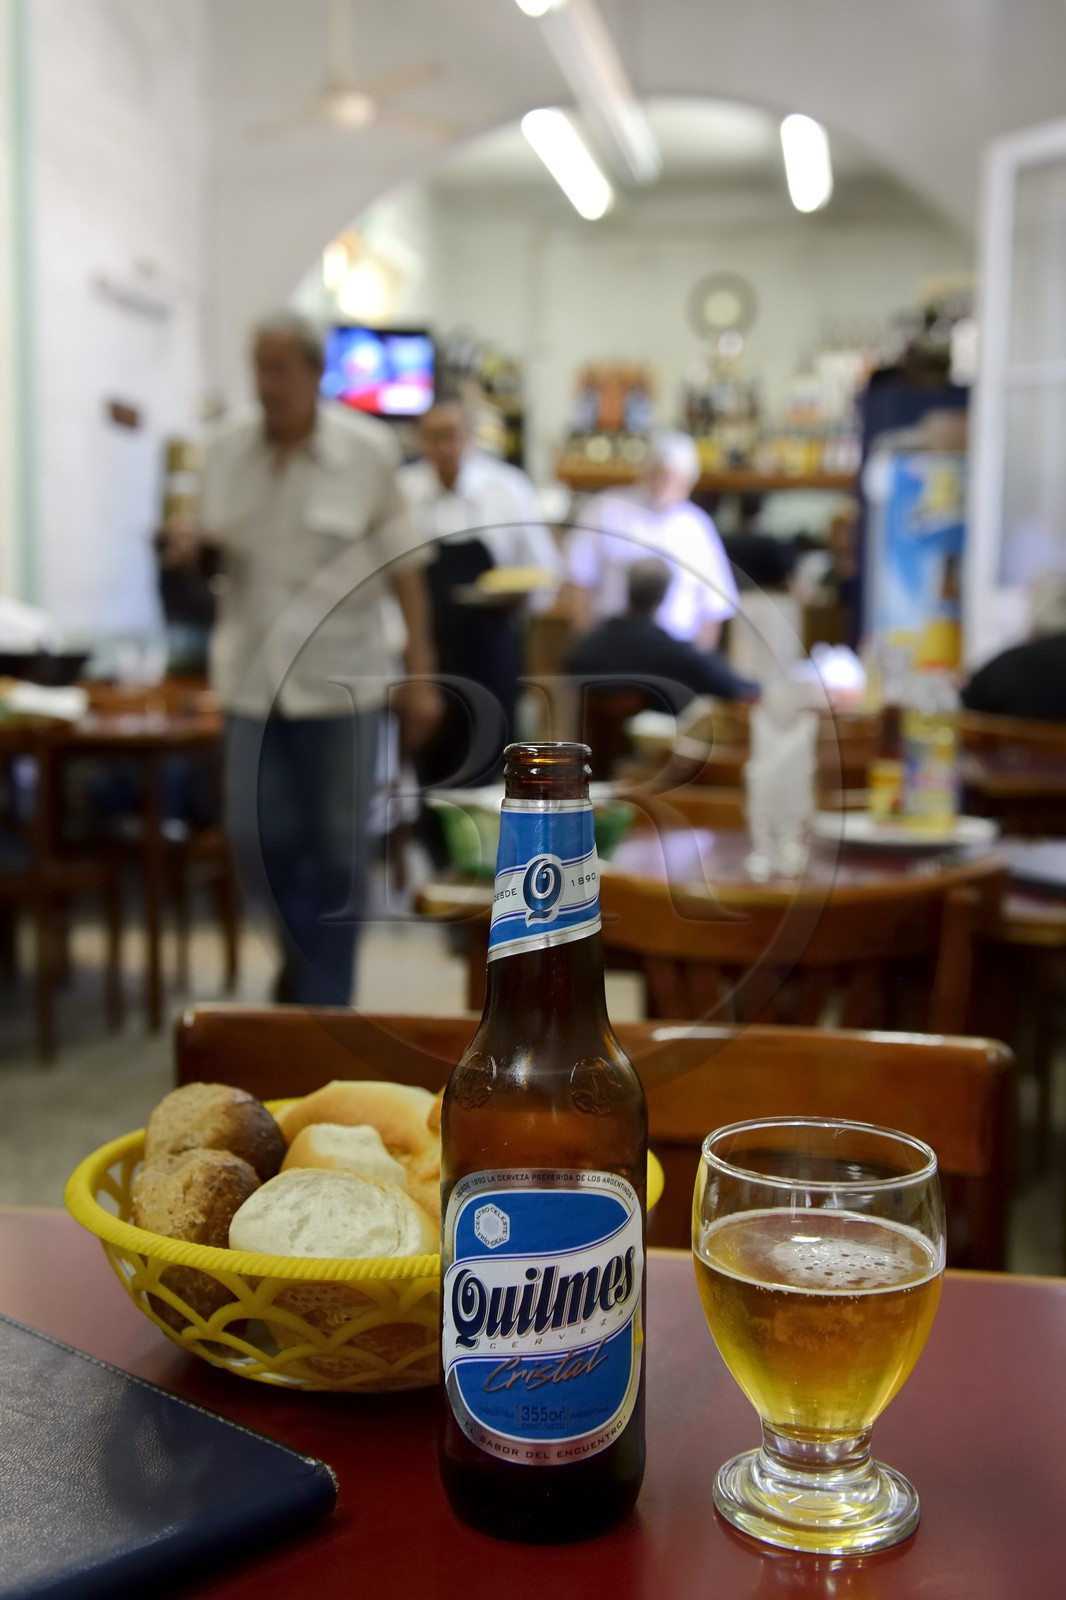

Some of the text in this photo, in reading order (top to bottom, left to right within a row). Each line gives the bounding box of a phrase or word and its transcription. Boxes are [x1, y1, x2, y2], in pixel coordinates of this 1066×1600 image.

[570, 872, 596, 887] 1890
[471, 1176, 486, 1186] 1890
[496, 1174, 530, 1182] CERVEZA
[576, 1174, 586, 1182] DE
[602, 1177, 632, 1199] ARGENTINOS
[476, 1206, 508, 1234] CENTRO CELESTE
[452, 1246, 635, 1348] Quilmes
[489, 1309, 624, 1350] CERVEZA
[484, 1339, 609, 1394] Cristal
[480, 1435, 519, 1456] SABOR
[526, 1452, 550, 1460] DEL
[556, 1421, 623, 1458] ENCUENTRO
